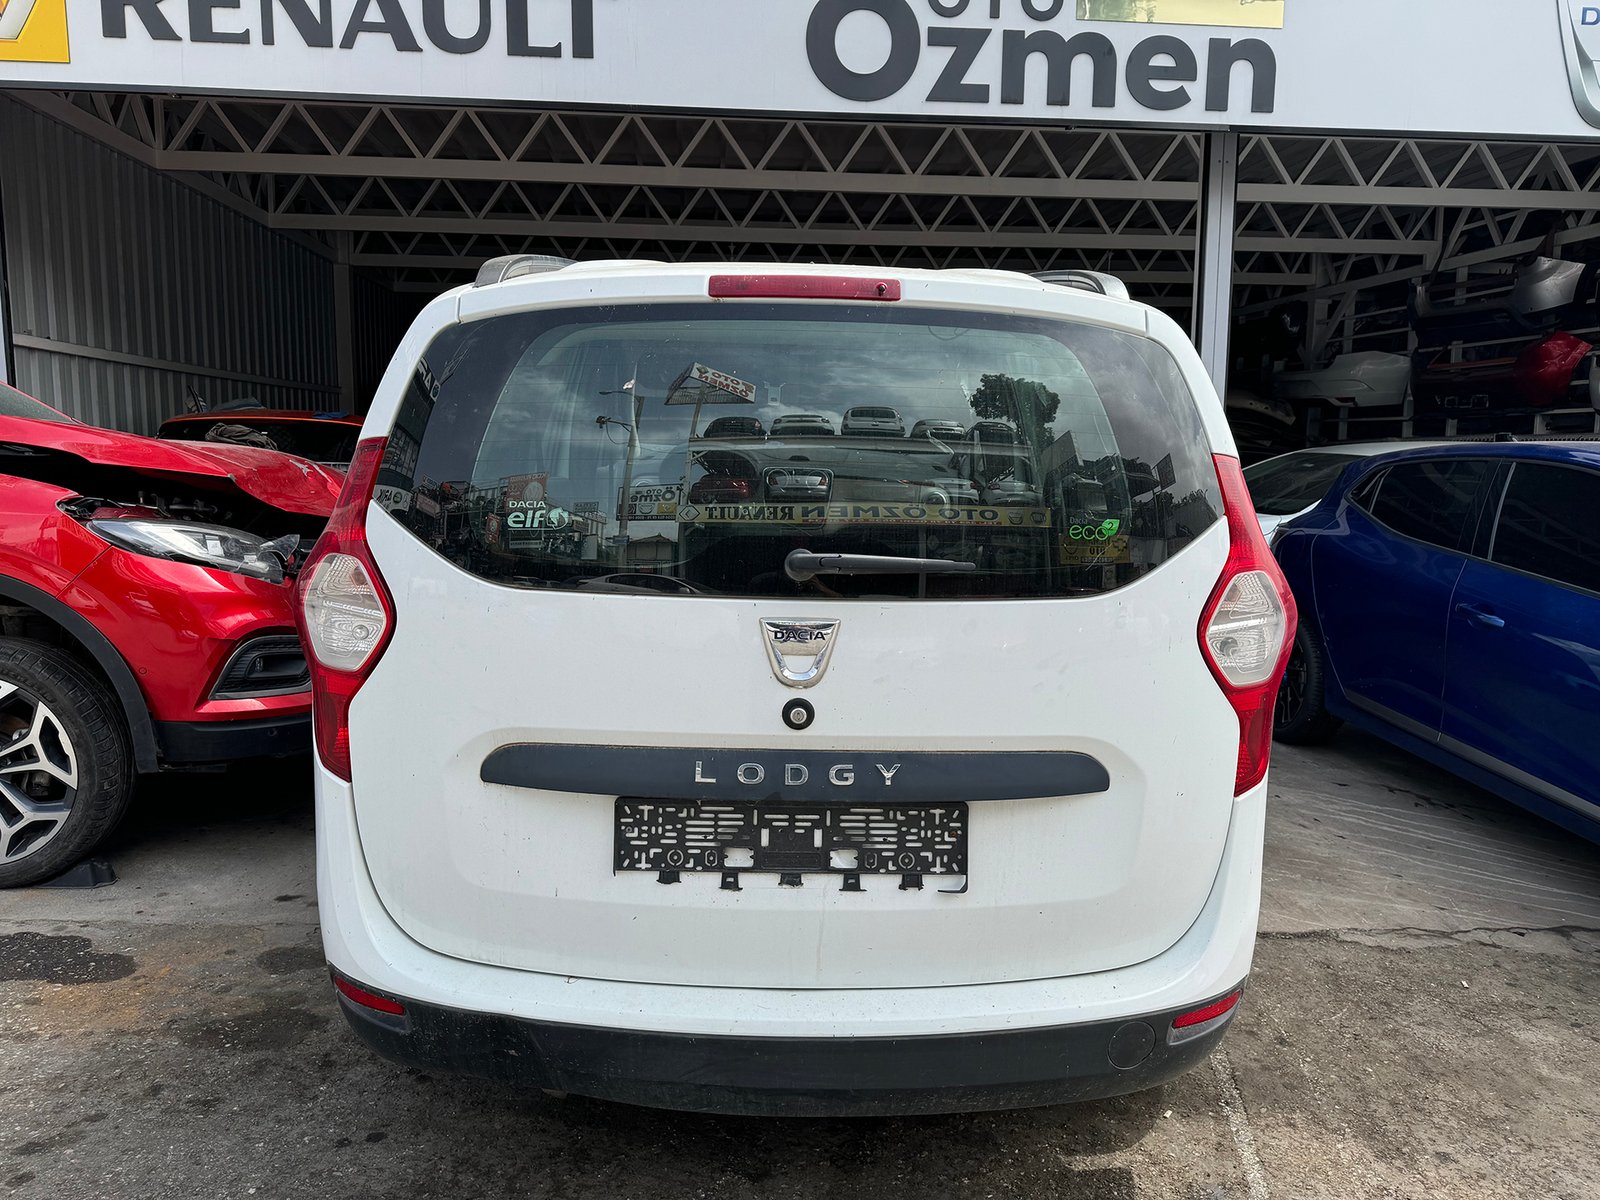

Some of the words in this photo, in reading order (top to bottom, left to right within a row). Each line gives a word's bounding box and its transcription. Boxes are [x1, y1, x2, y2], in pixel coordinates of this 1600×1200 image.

[509, 500, 546, 508] DACIA
[507, 510, 546, 528] elf
[773, 629, 827, 641] DACIA
[694, 760, 902, 786] LODGY
